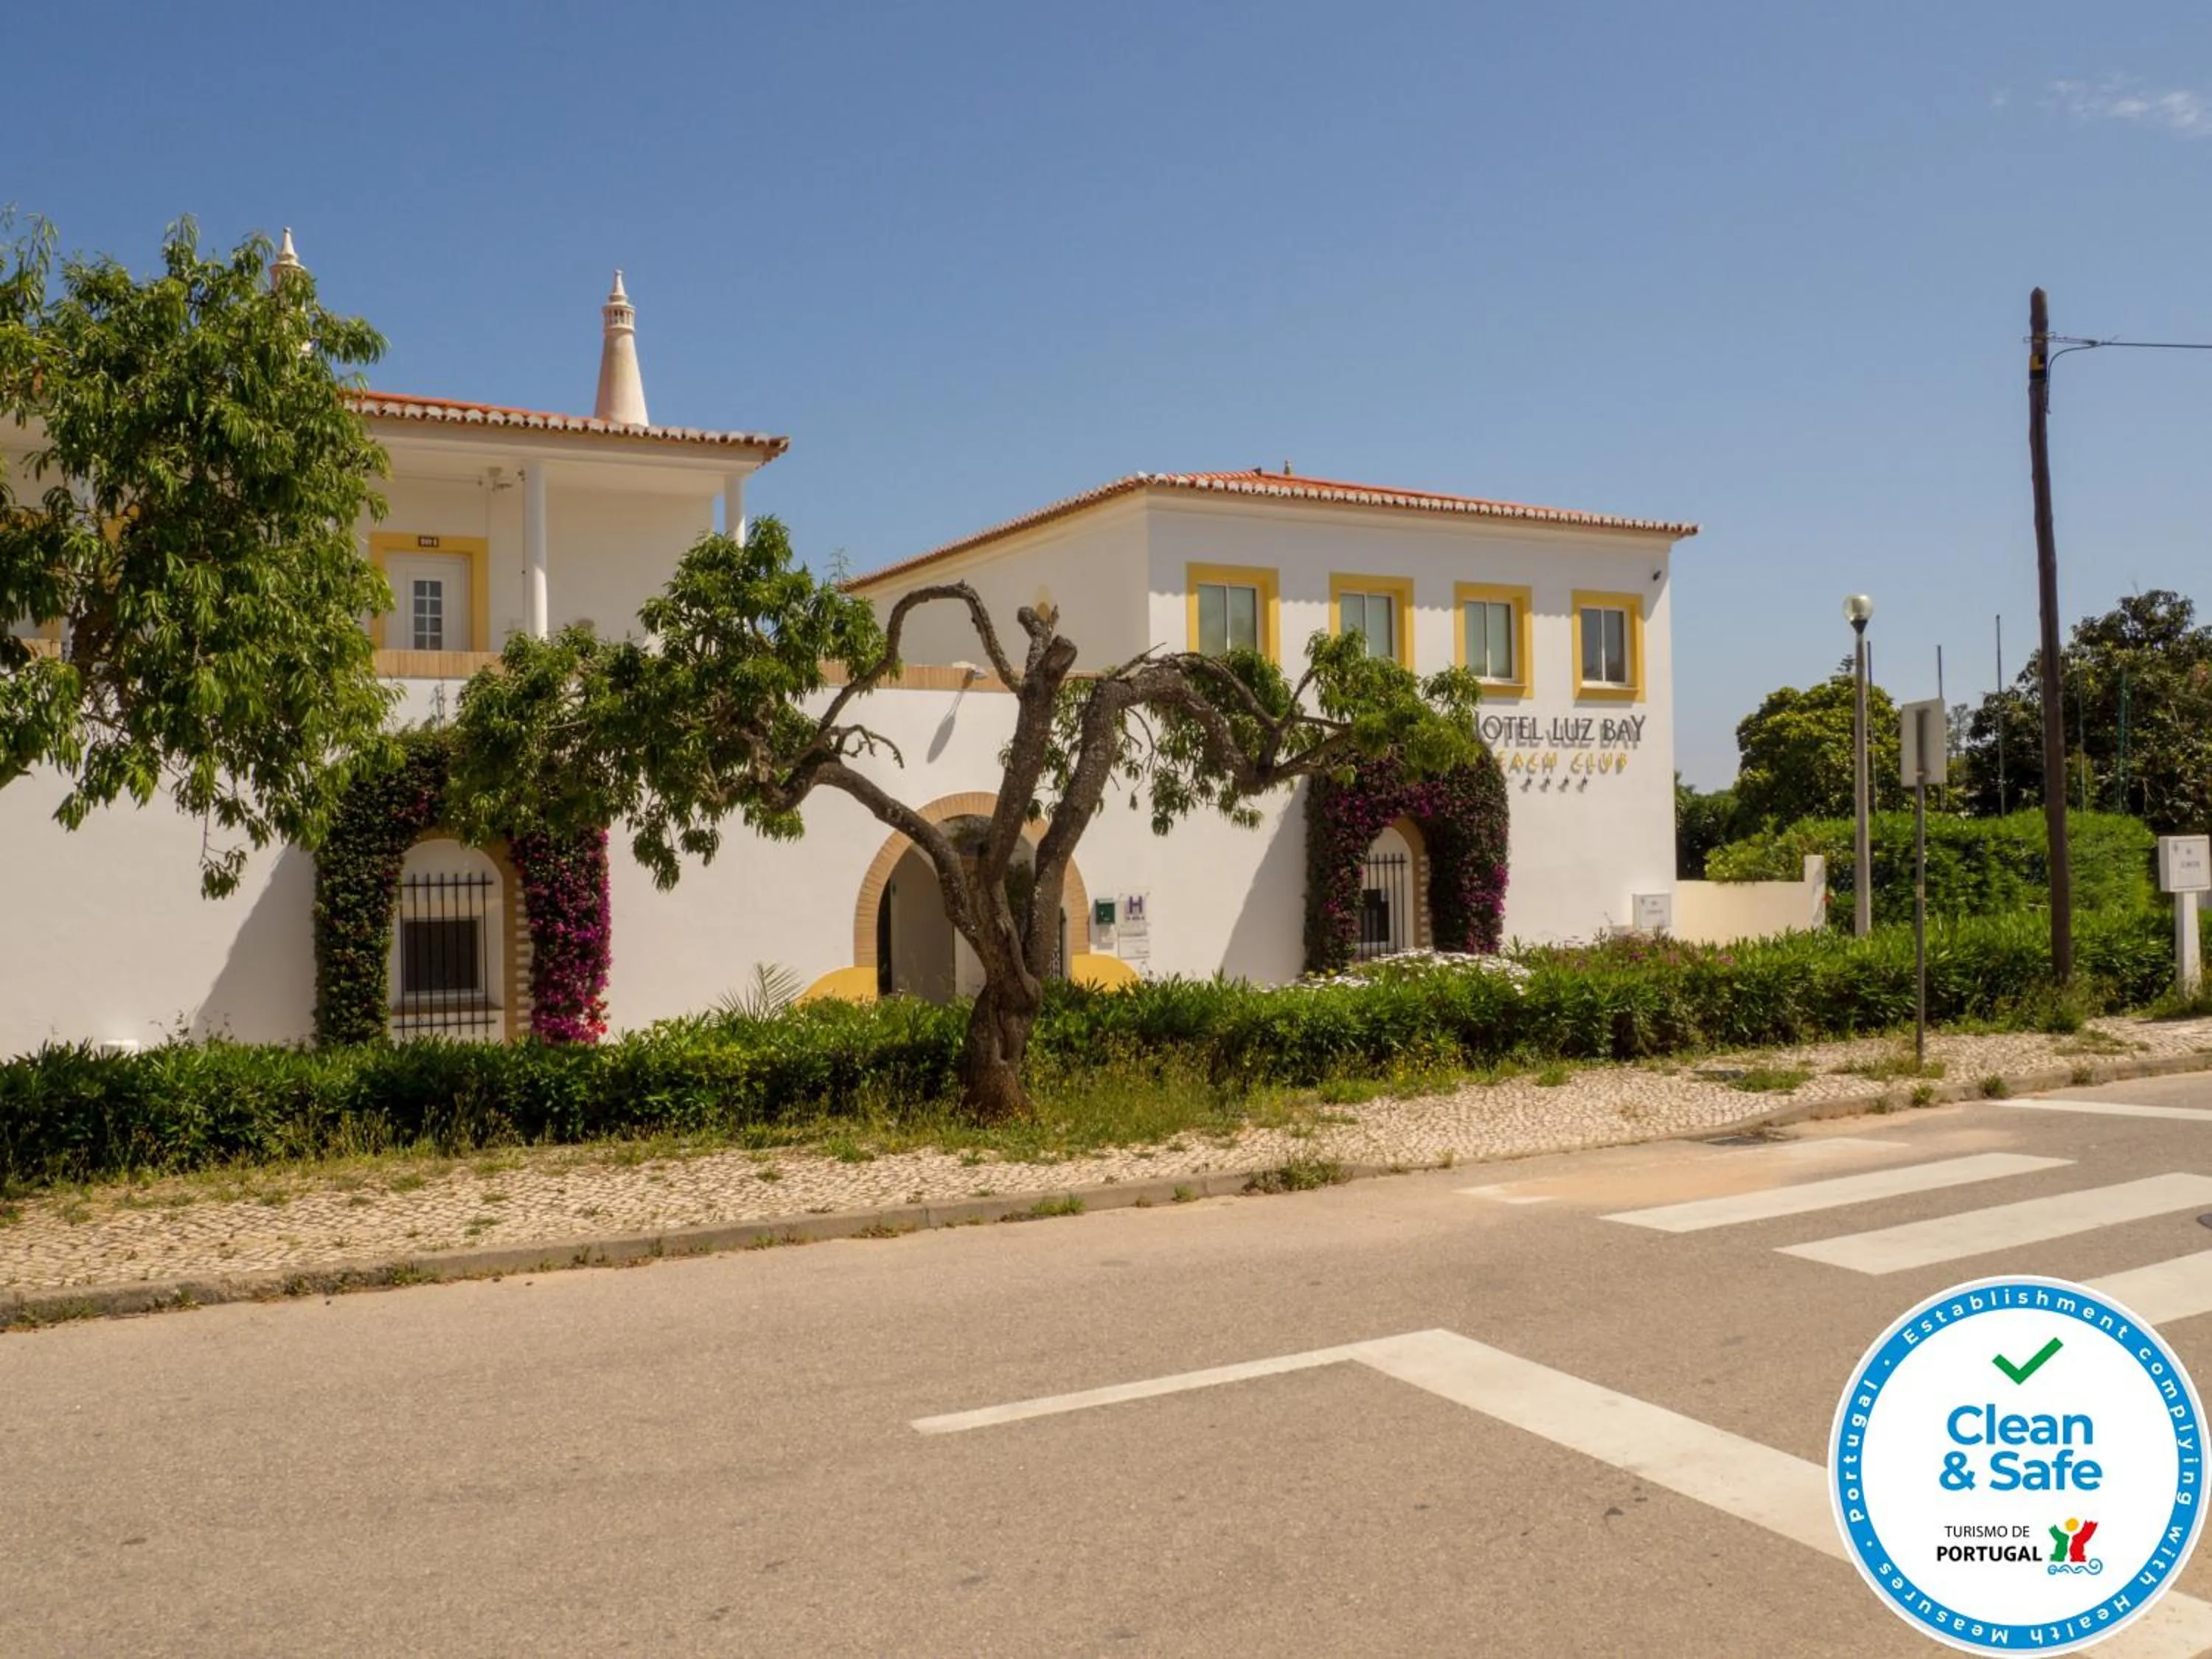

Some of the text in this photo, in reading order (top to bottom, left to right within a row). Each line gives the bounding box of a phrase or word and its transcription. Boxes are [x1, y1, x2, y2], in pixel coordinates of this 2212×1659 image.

[1553, 717, 1595, 742] LUZ
[1602, 714, 1646, 742] BAY
[1495, 751, 1627, 772] EACH CLUB
[1129, 896, 1143, 914] H
